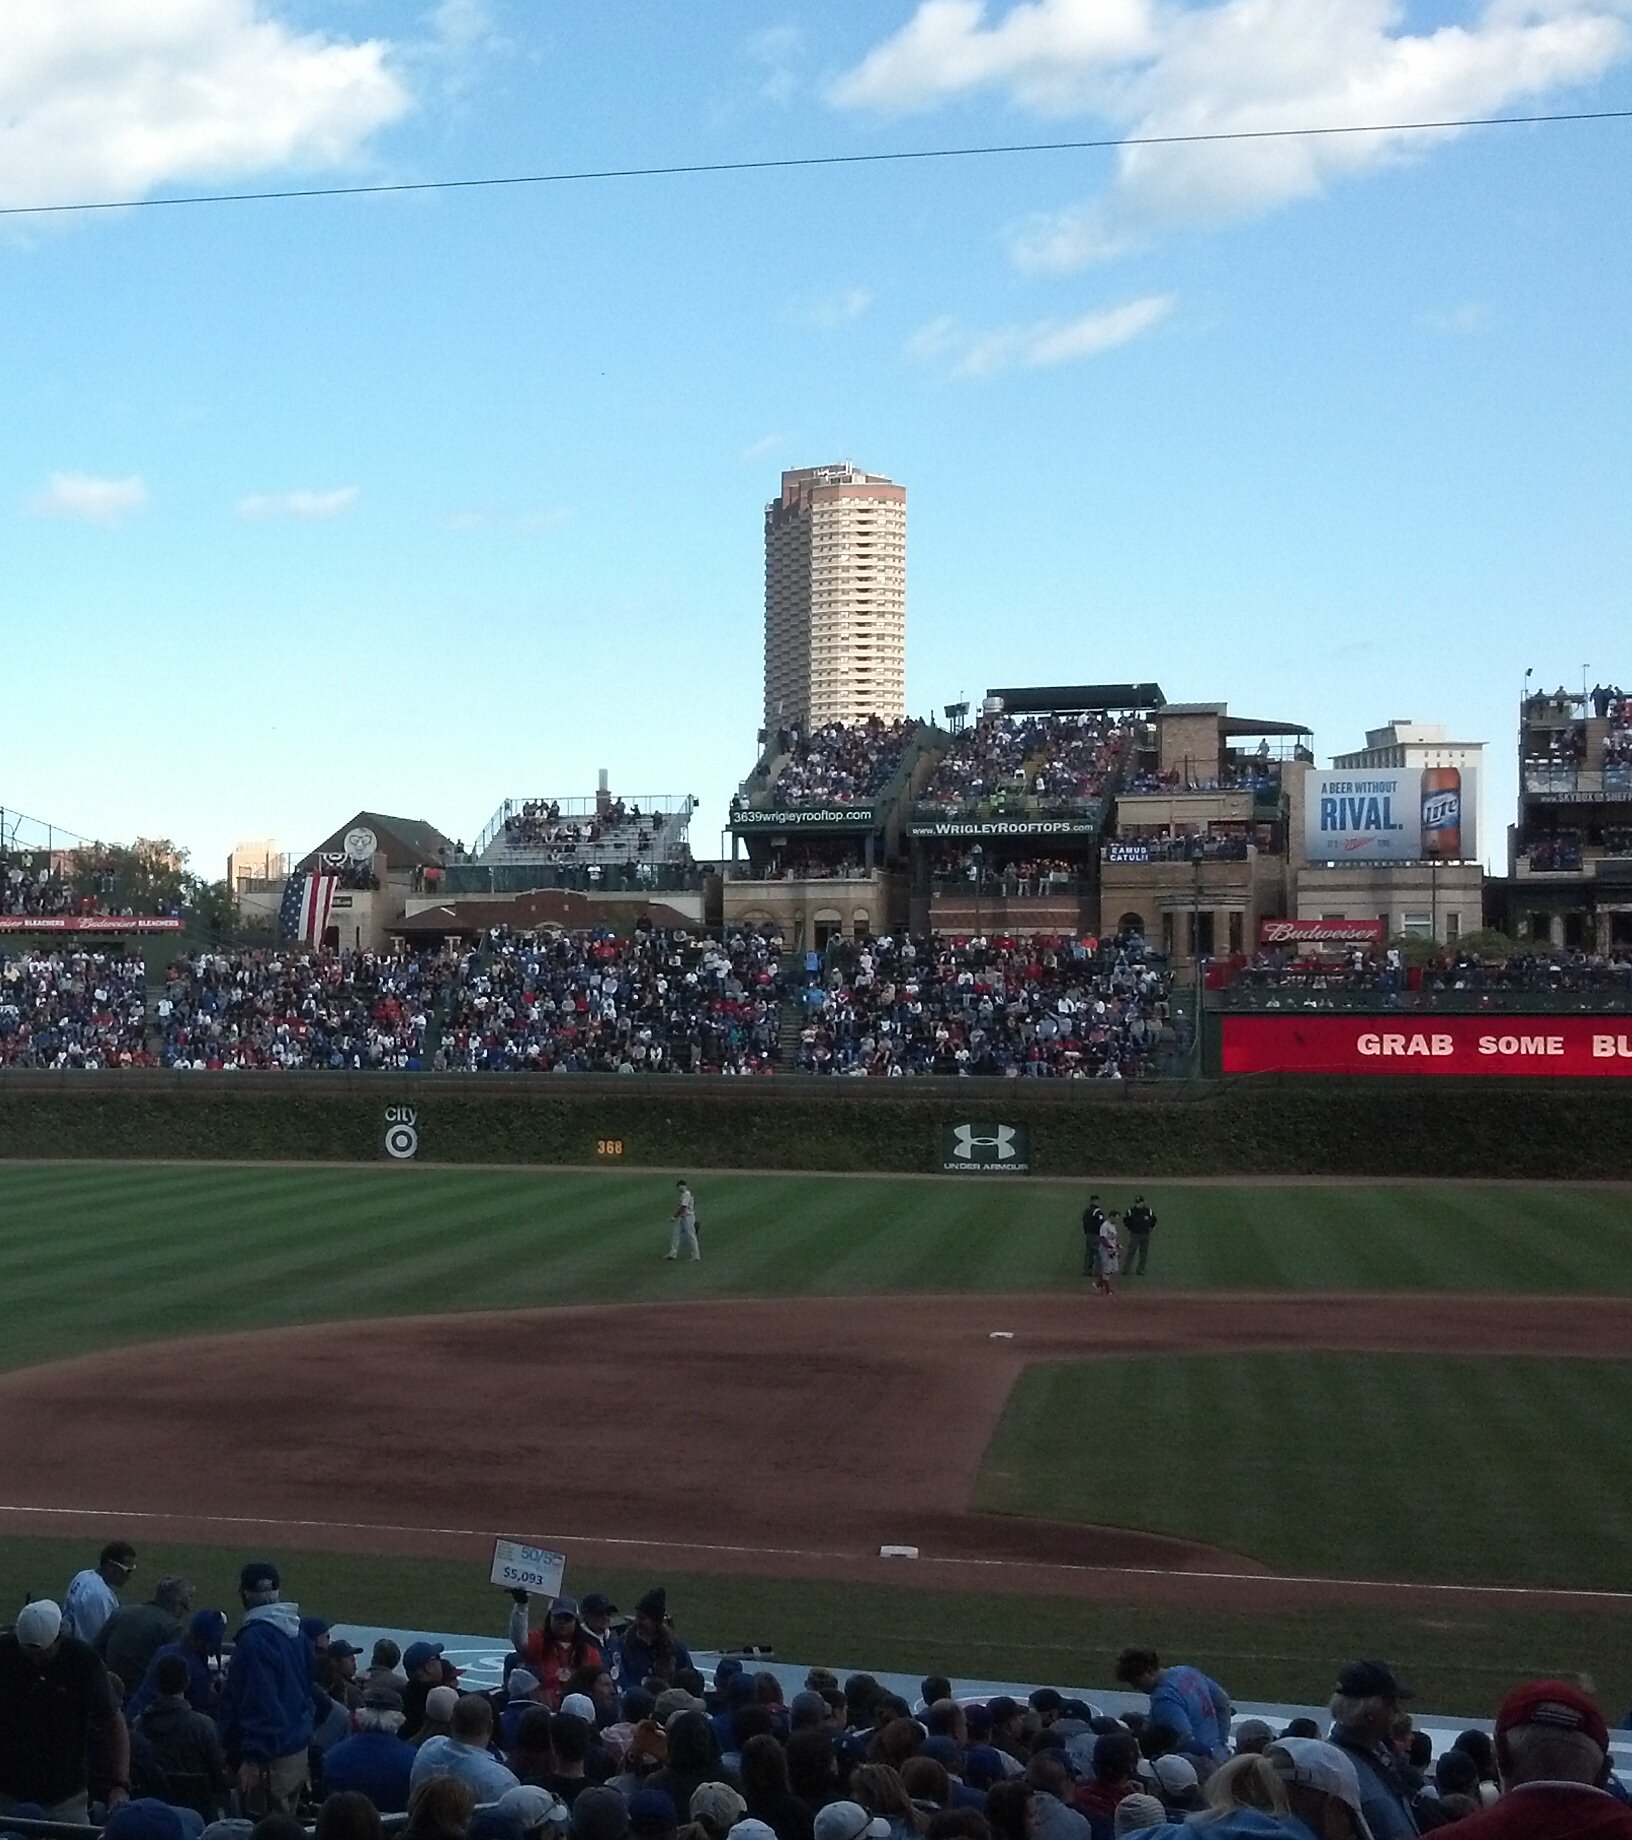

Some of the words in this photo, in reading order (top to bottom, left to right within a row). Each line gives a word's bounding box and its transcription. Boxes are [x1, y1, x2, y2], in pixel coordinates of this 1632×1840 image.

[1321, 782, 1327, 794] A
[1329, 782, 1353, 794] BEER
[1354, 781, 1398, 794] WITHOUT
[733, 810, 871, 823] 3639wrigleyrooftop.com
[1321, 797, 1404, 831] RIVAL.
[912, 822, 1093, 835] www.WRIGLEYROOFTOPS.com
[78, 917, 137, 928] Budweiser
[1264, 923, 1377, 941] Budweiser
[1357, 1034, 1453, 1056] GRAB
[1478, 1036, 1564, 1055] SOME
[385, 1106, 417, 1126] city
[598, 1140, 623, 1154] 368
[521, 1546, 562, 1565] 50/5
[503, 1566, 543, 1585] $5,093
